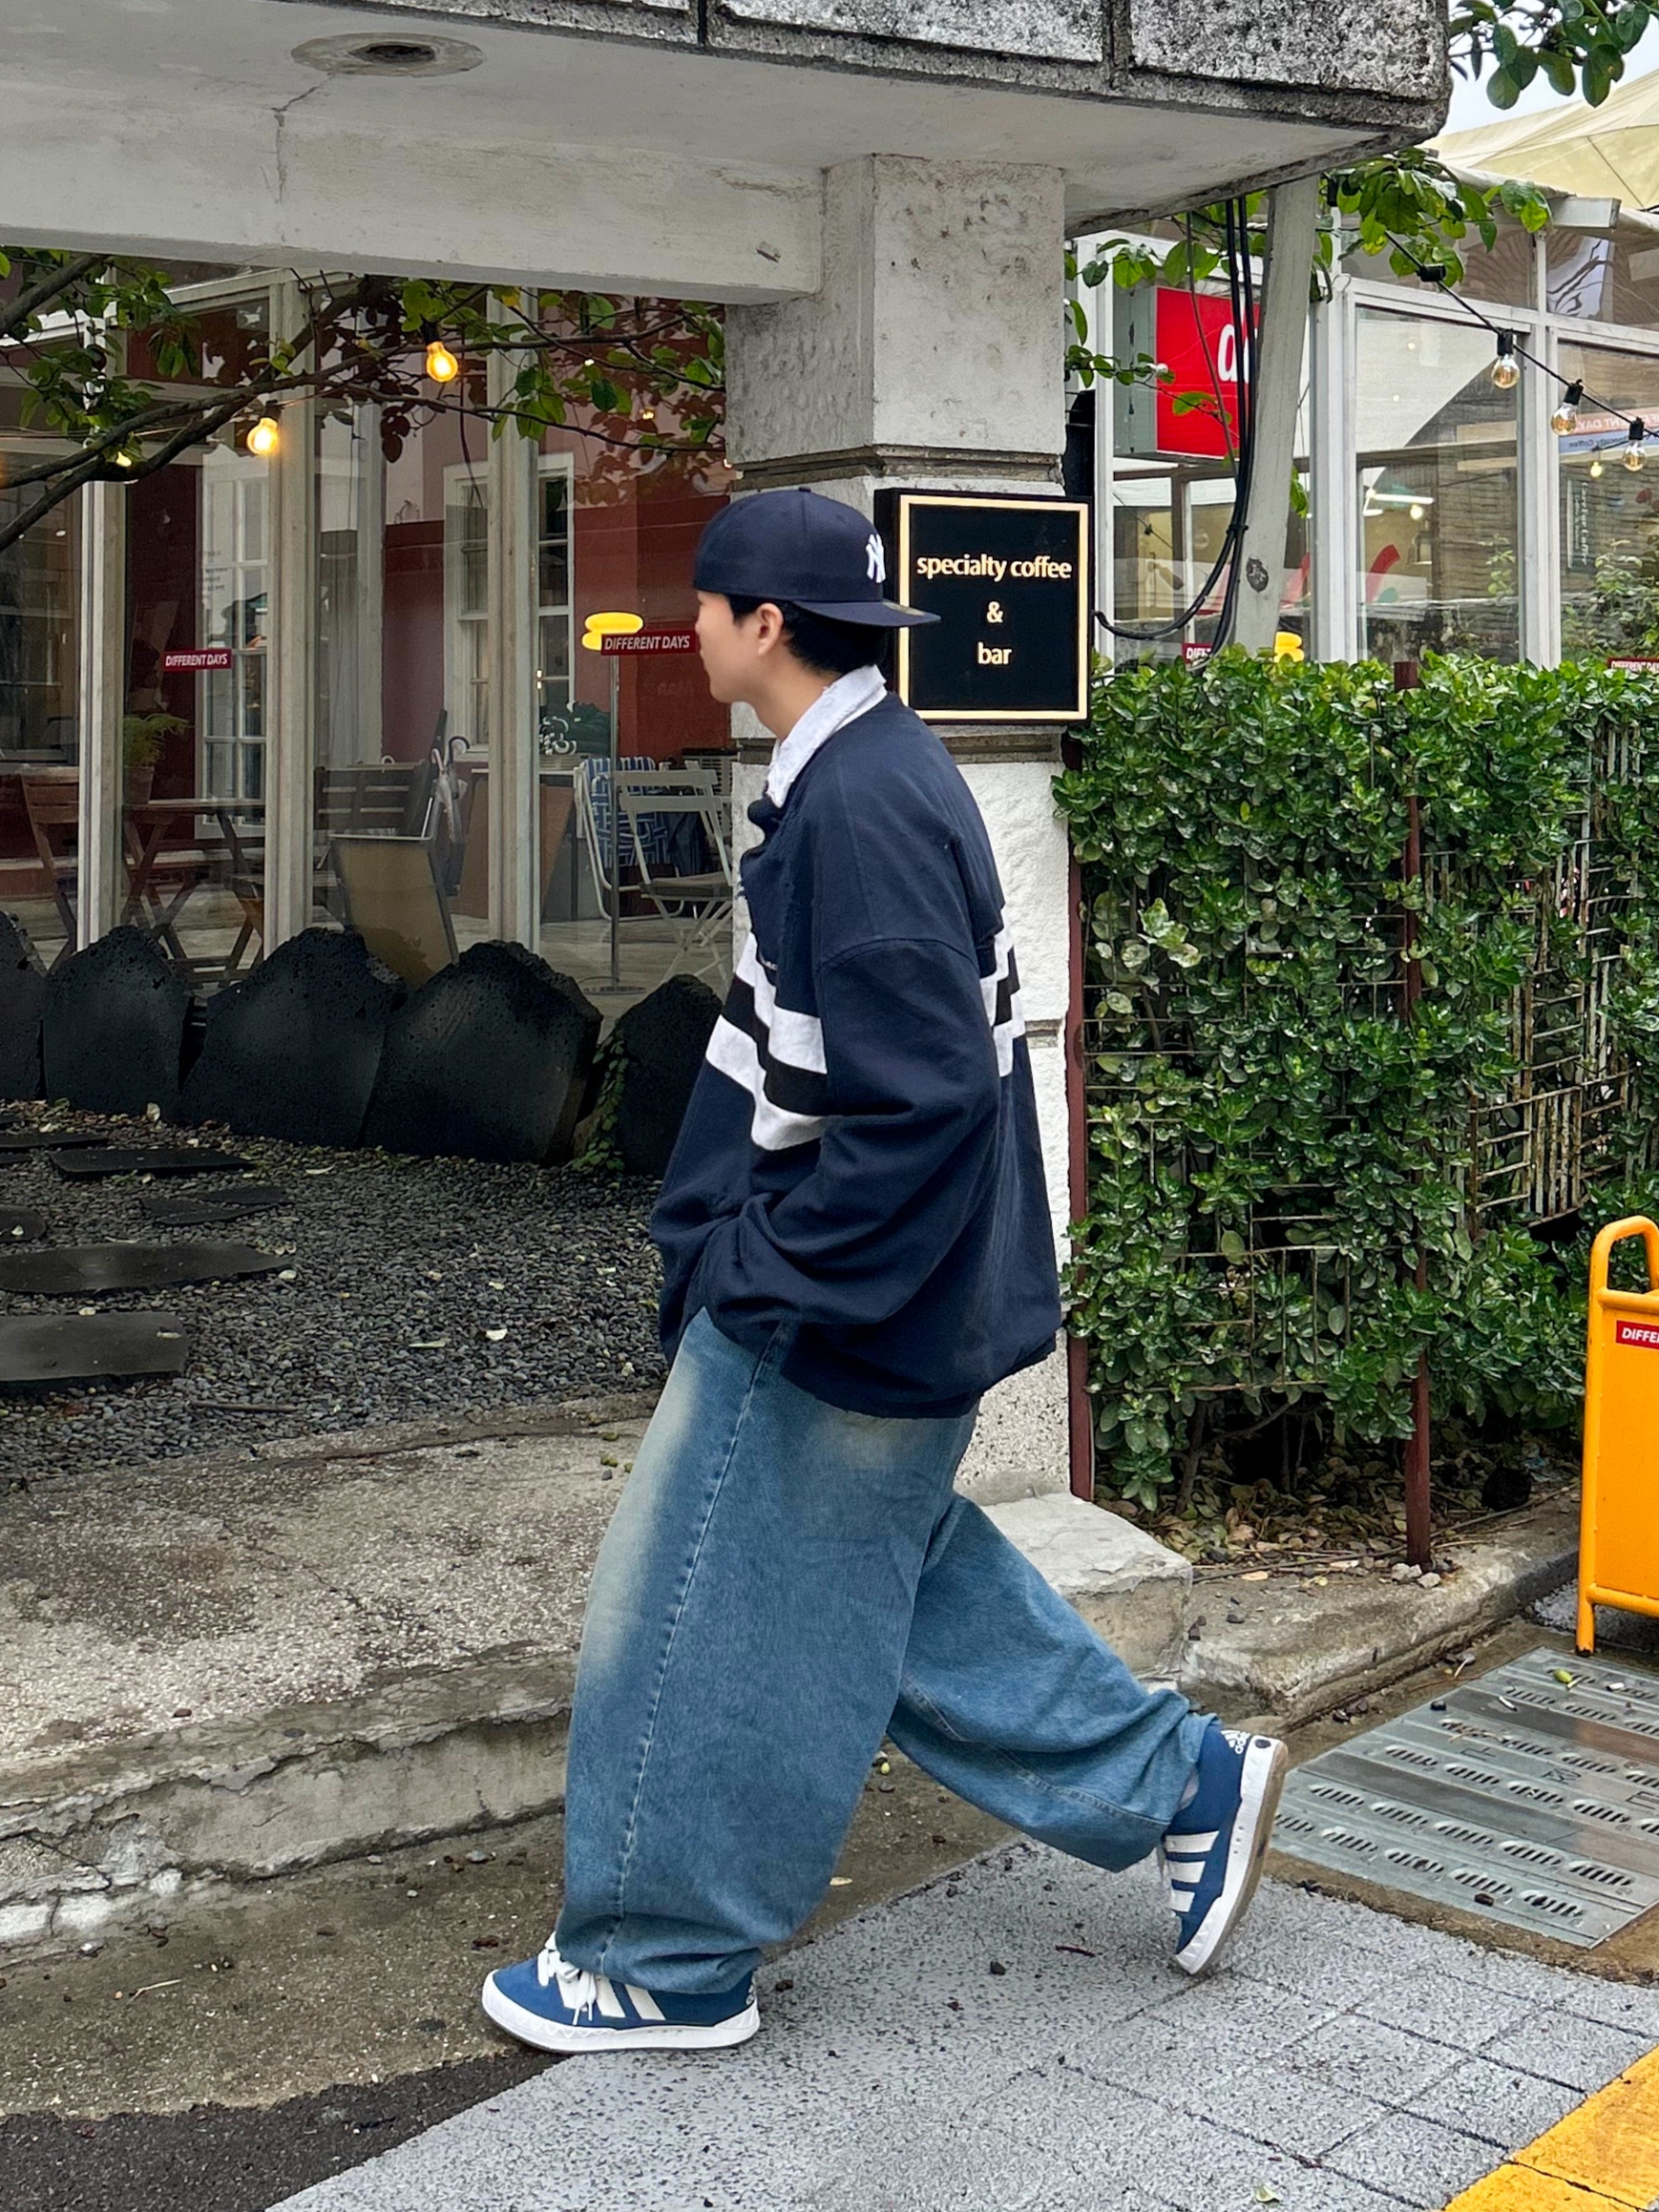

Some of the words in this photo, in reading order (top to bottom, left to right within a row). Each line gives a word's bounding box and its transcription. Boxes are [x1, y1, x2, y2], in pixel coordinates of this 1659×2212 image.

[916, 553, 1007, 582] specialty
[1010, 555, 1073, 578] coffee
[986, 601, 1003, 623] &
[604, 636, 662, 651] DIFFERENT
[662, 636, 690, 649] DAYS
[977, 641, 1012, 665] bar
[165, 655, 206, 666] DIFFERENT
[206, 653, 227, 665] DAYS
